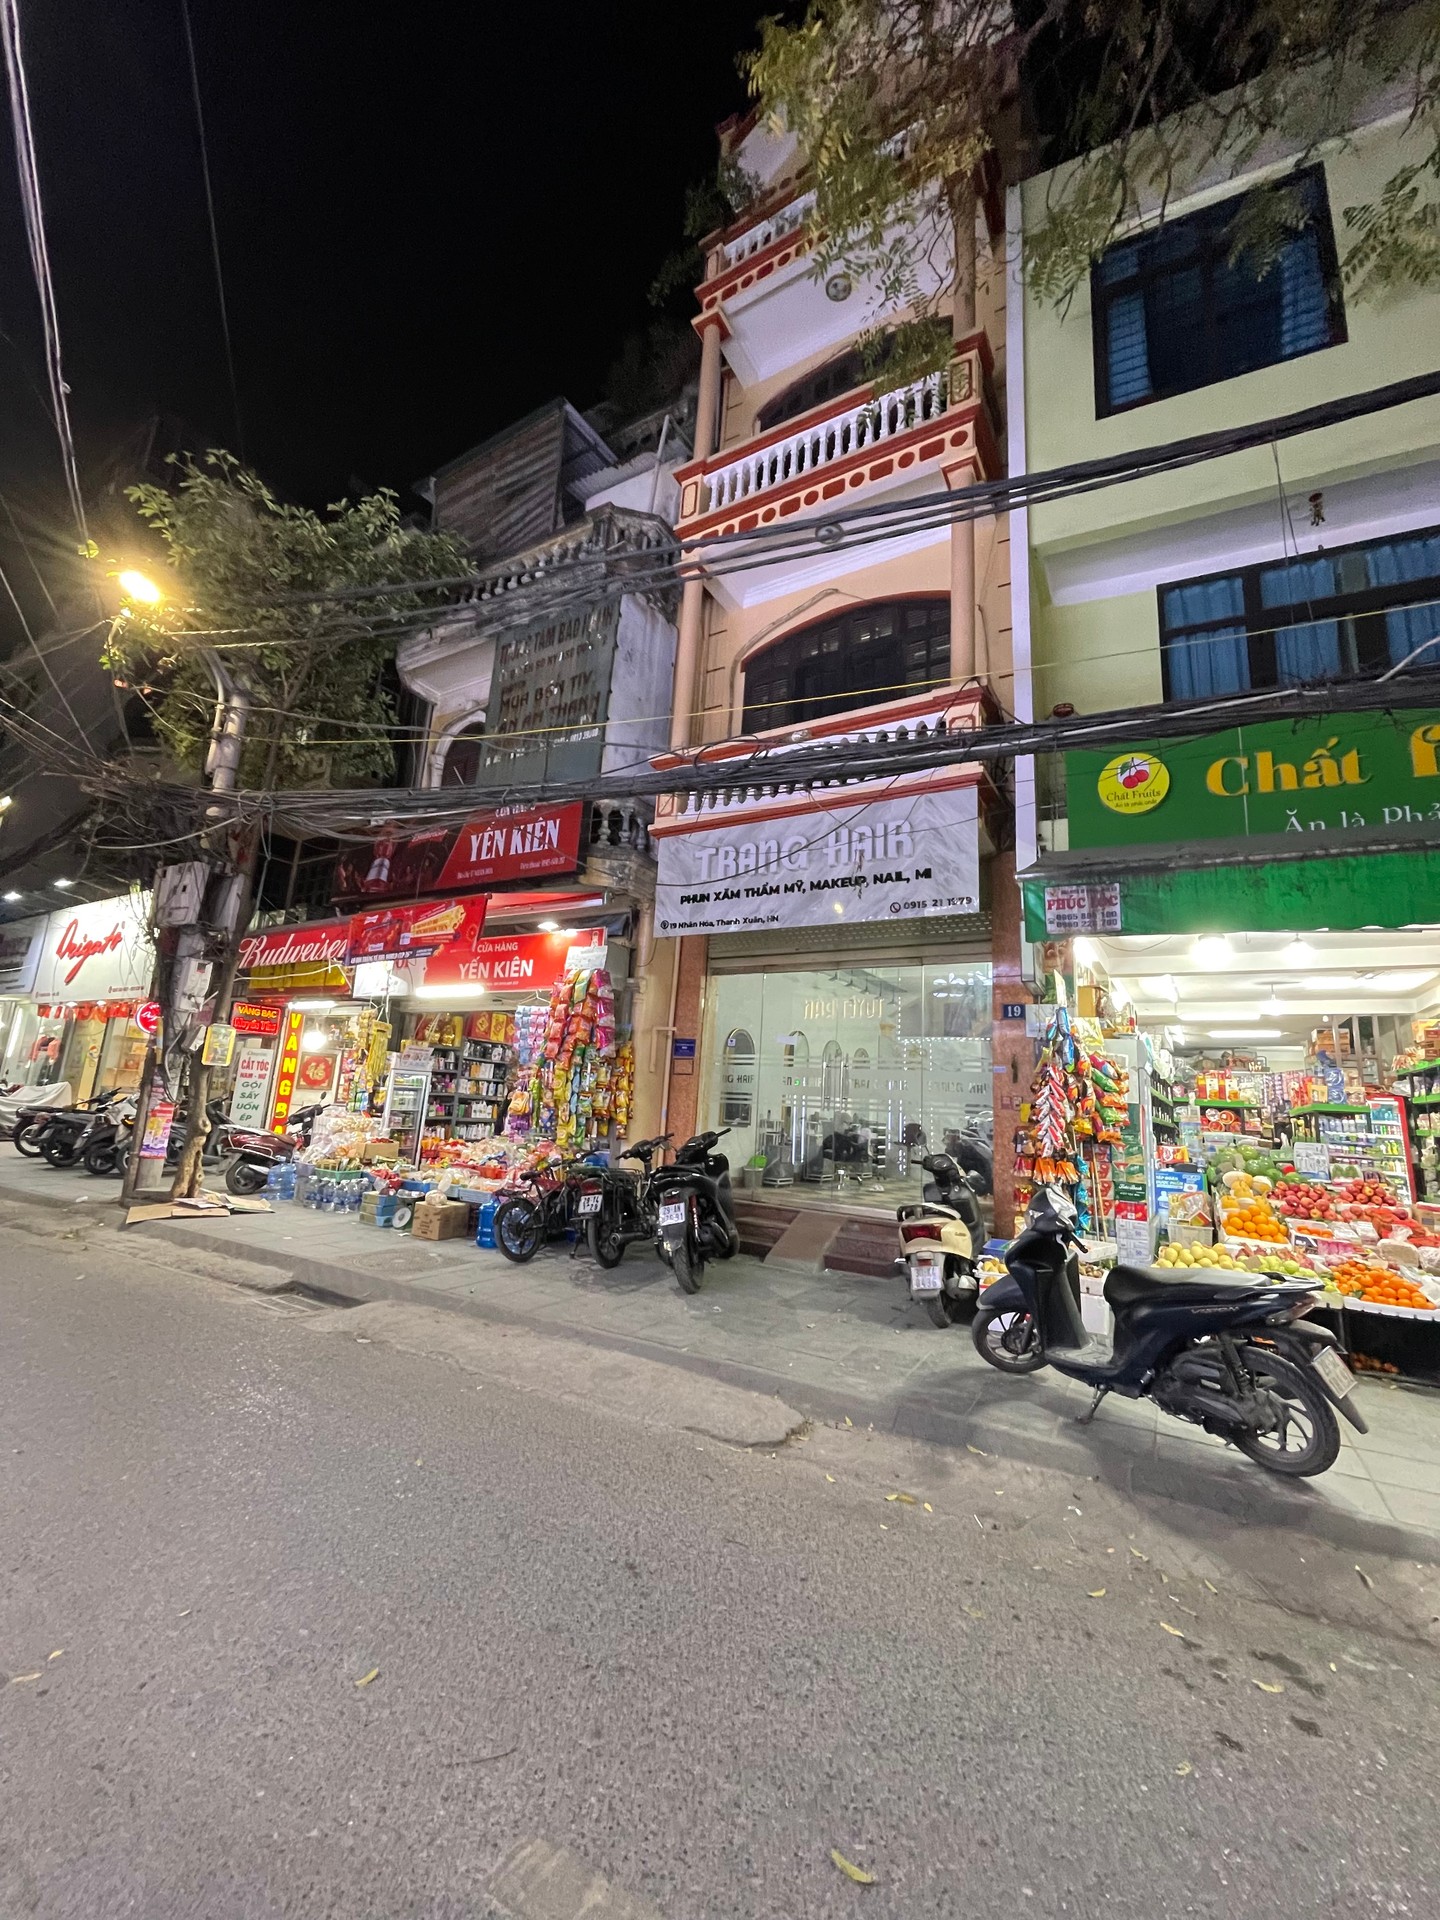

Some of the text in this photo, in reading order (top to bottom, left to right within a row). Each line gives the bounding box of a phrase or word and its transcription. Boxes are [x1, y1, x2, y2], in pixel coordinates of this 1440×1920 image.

[1206, 737, 1373, 796] Chất
[1132, 788, 1161, 799] Fruits
[1285, 808, 1326, 833] Ăn
[470, 816, 561, 862] YẾN KIÊN
[695, 818, 916, 882] TRANG HAIR
[680, 893, 711, 906] PHUN
[713, 887, 741, 902] XĂM
[744, 881, 780, 899] THẨM
[784, 879, 806, 895] MỸ,
[873, 870, 910, 886] NAIL,
[915, 867, 932, 880] MI
[903, 901, 927, 910] 0915
[1047, 895, 1086, 911] PHÚC
[716, 918, 740, 926] Thanh
[239, 933, 348, 969] Budweiser
[477, 941, 518, 953] CỬA HÀNG
[459, 956, 534, 980] YẾN KIÊN
[238, 1005, 260, 1016] VÀNG
[1007, 1005, 1021, 1017] 19
[279, 1013, 302, 1097] VÀNG
[241, 1057, 269, 1071] CẮT TÓC
[241, 1081, 262, 1090] GỘI
[240, 1091, 259, 1100] SẤY
[236, 1101, 259, 1110] UỐN
[239, 1113, 252, 1121] ÉP
